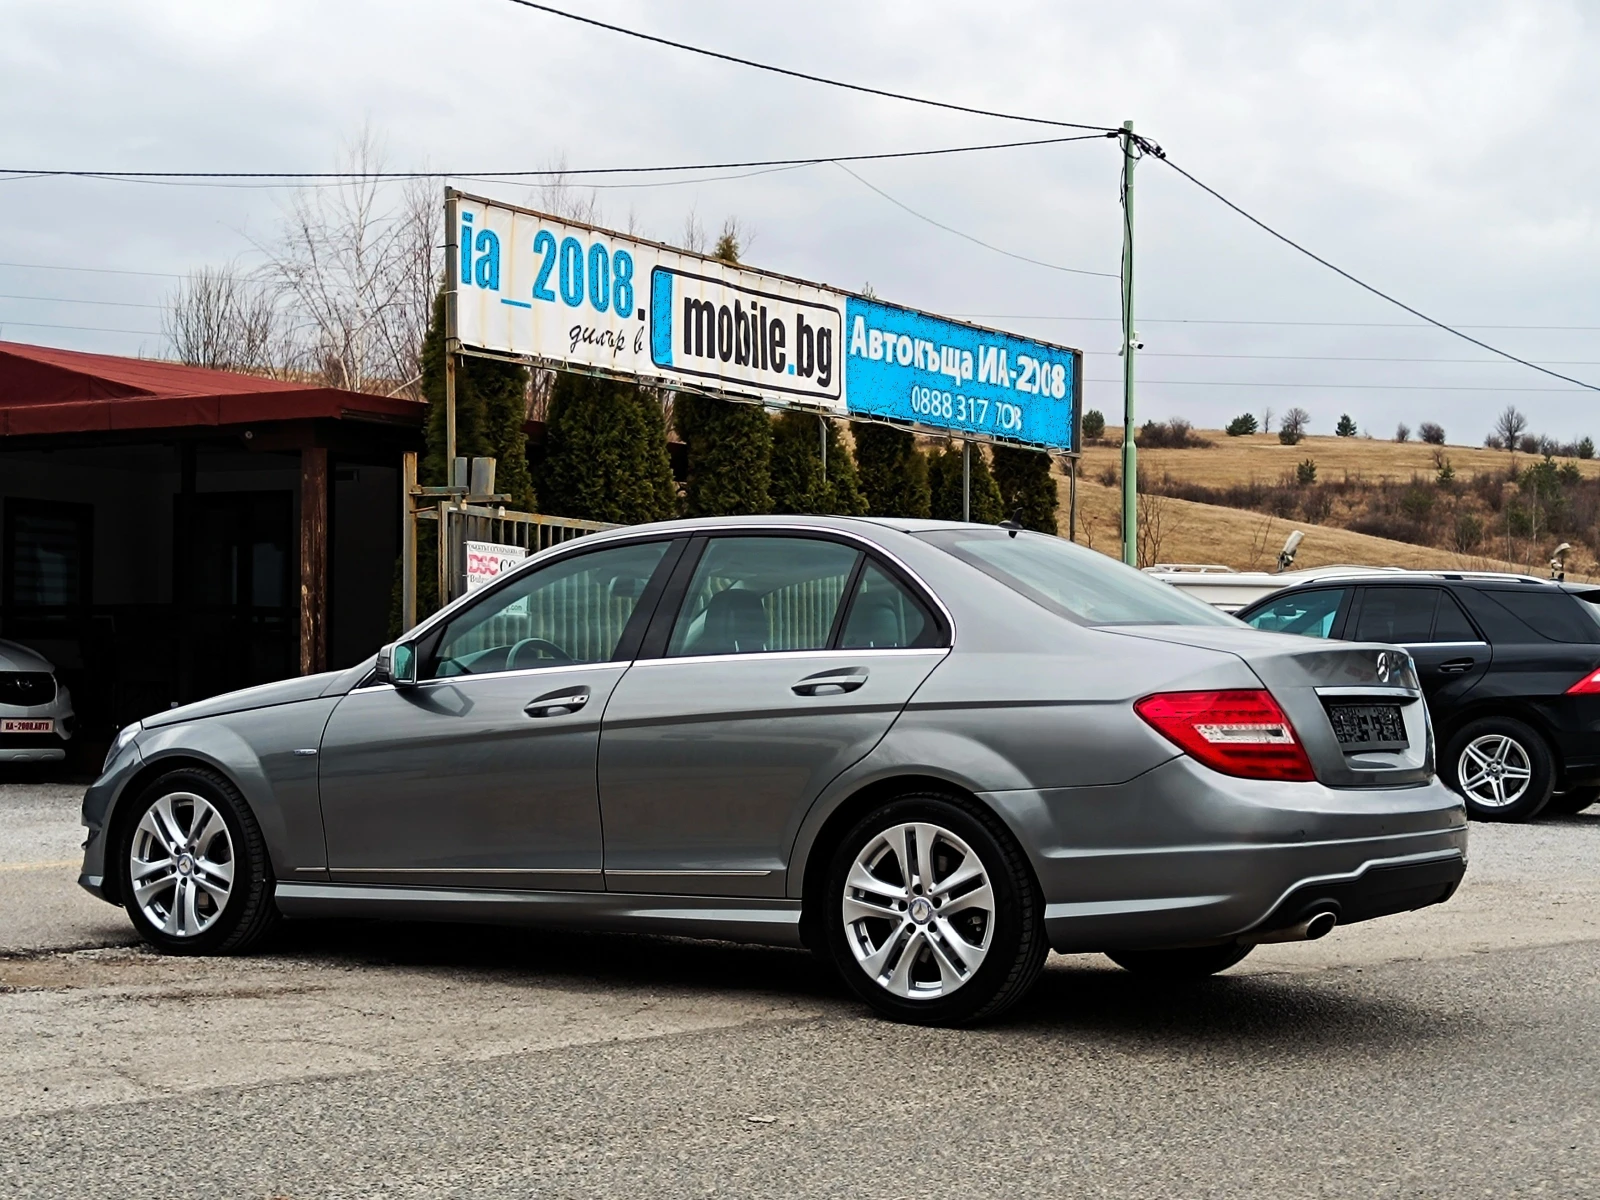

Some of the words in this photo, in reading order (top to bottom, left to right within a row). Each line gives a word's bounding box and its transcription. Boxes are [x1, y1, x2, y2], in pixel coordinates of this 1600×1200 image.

[569, 325, 626, 358] дилър
[684, 297, 832, 388] mobile.bg
[850, 315, 973, 386] Автокъща
[911, 386, 952, 419] 0888
[956, 395, 989, 424] 317
[995, 401, 1022, 431] 708
